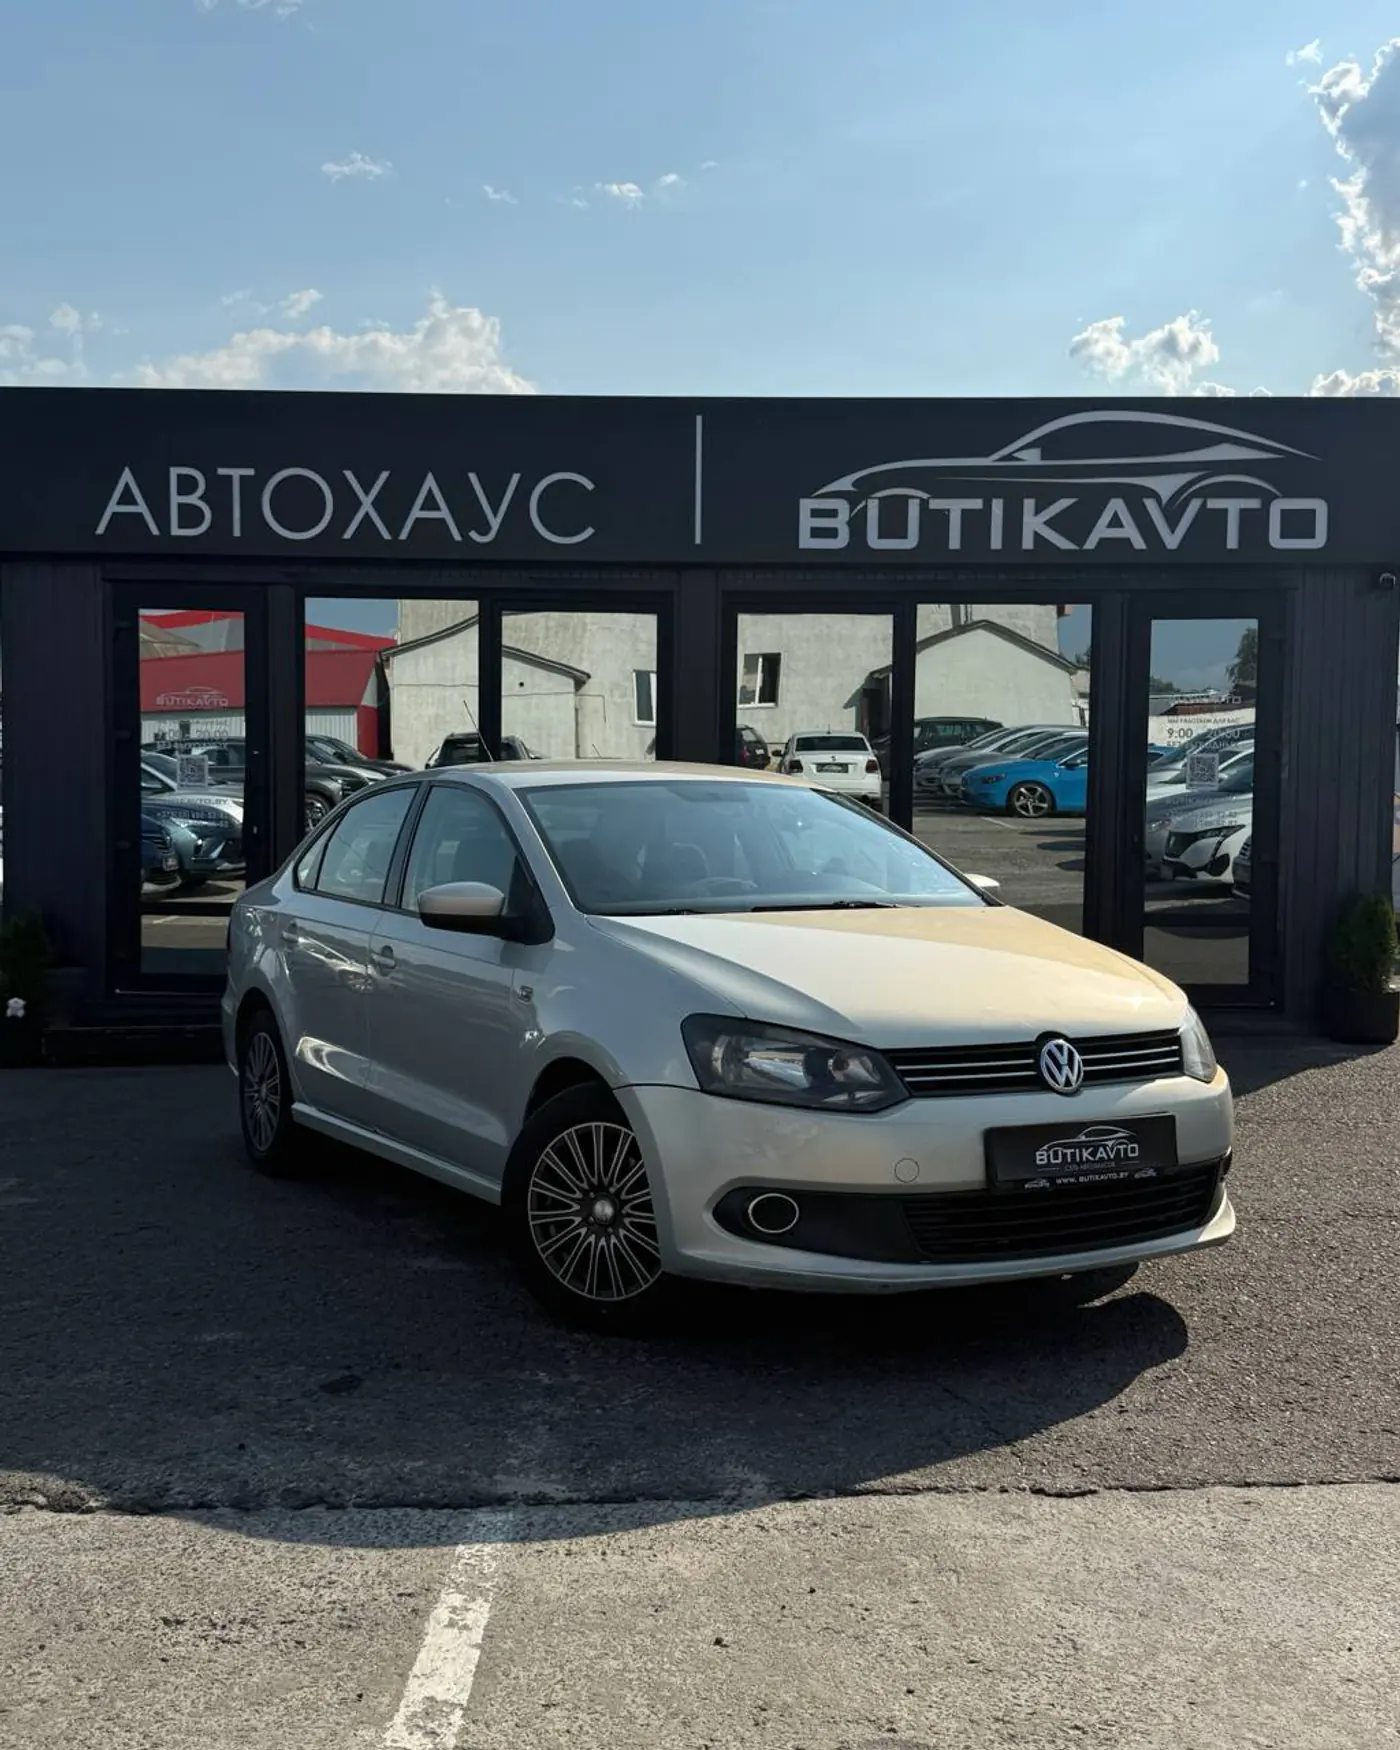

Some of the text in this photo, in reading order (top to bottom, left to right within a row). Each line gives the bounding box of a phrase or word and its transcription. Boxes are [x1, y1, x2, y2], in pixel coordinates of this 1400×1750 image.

[95, 465, 596, 545] АВТОХАУС
[799, 496, 1328, 551] BUTIKAVTO
[1167, 728, 1194, 739] 9:00
[1036, 1143, 1139, 1165] BUTIKAVTO
